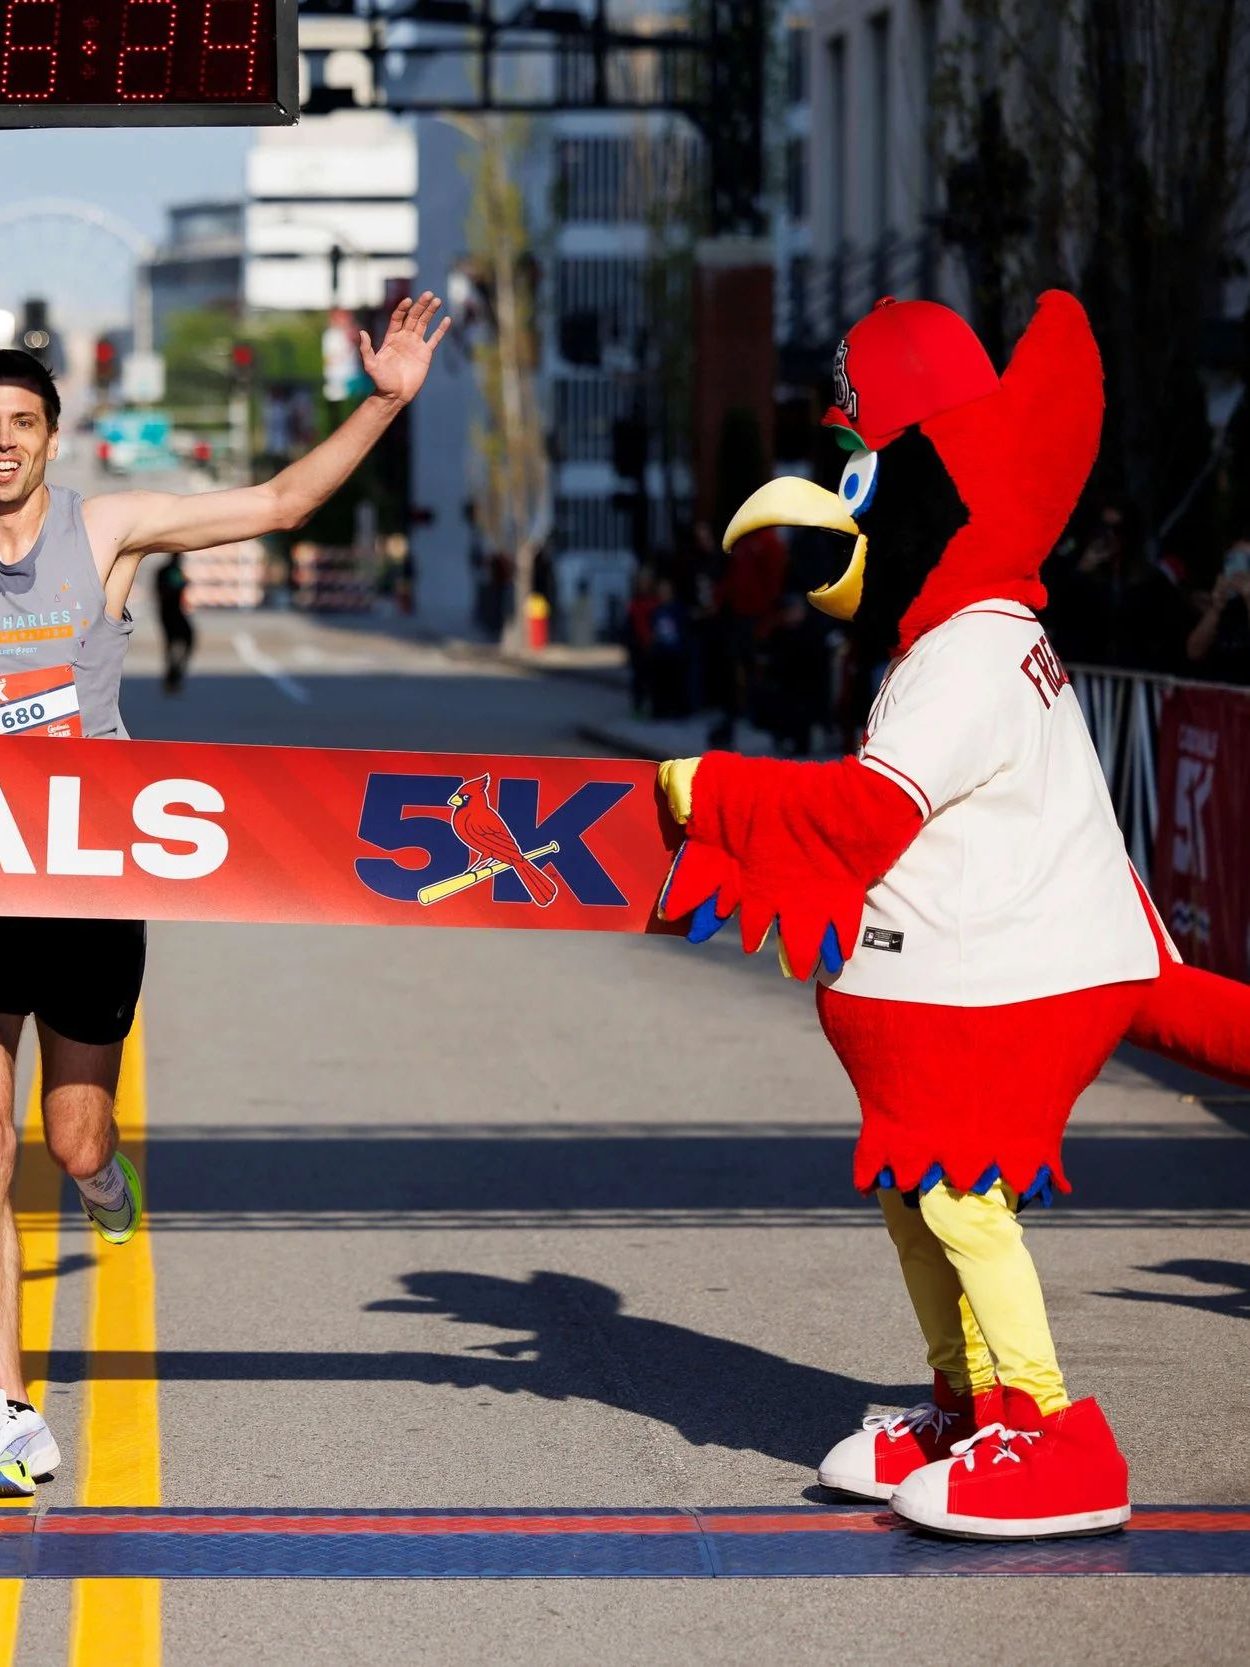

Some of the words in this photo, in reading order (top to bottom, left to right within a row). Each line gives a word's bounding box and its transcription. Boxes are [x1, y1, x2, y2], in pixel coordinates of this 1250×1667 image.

[1, 628, 69, 642] MARATHON
[1020, 633, 1070, 710] FRE
[1, 703, 45, 729] 680
[353, 771, 636, 908] 5K
